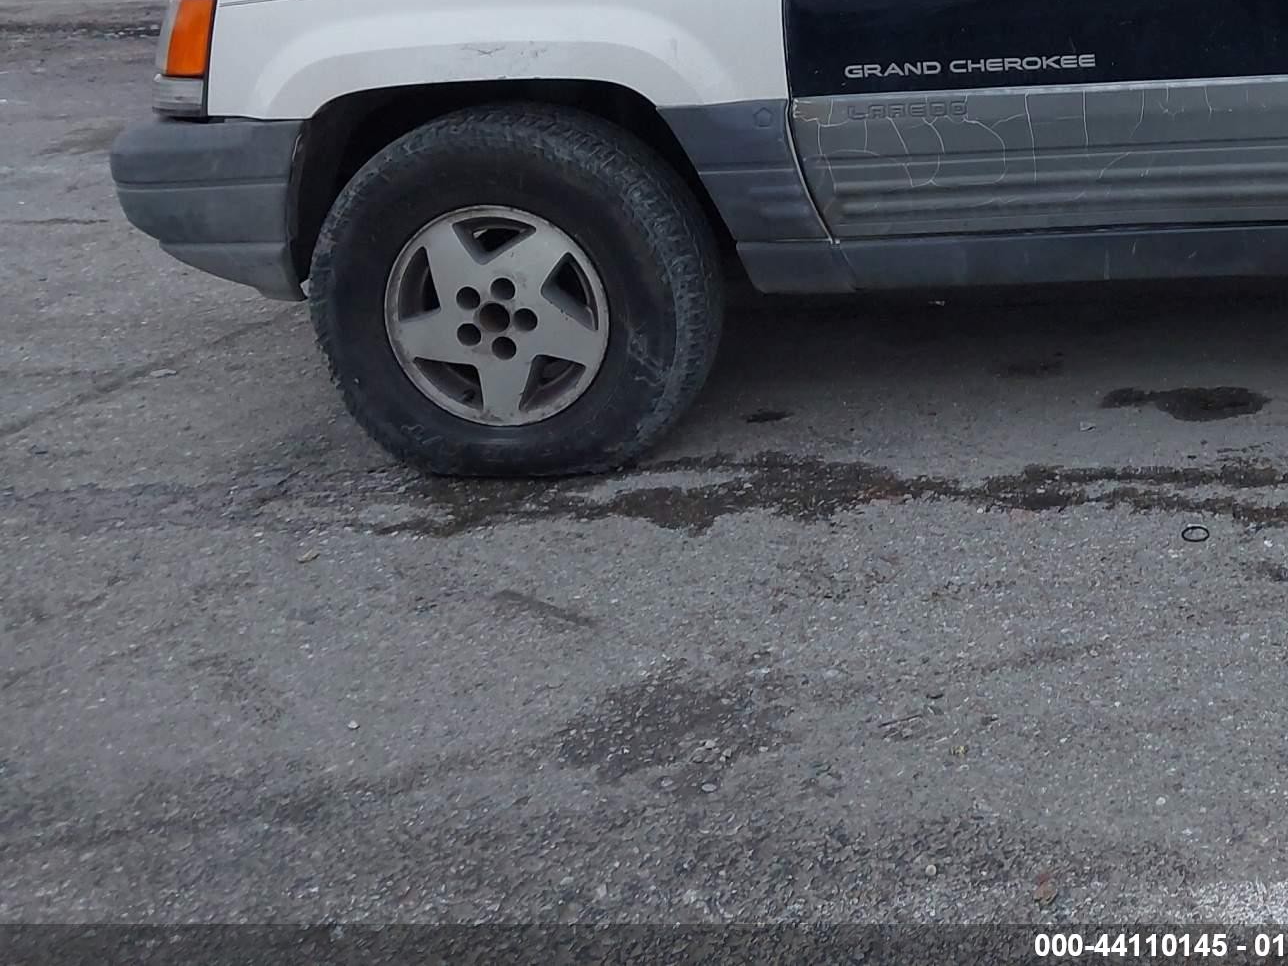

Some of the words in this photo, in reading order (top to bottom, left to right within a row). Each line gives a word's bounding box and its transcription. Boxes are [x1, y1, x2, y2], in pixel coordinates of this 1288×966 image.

[844, 61, 941, 78] GRAND
[949, 54, 1096, 73] CHEROKEE
[848, 99, 968, 120] LAREDO
